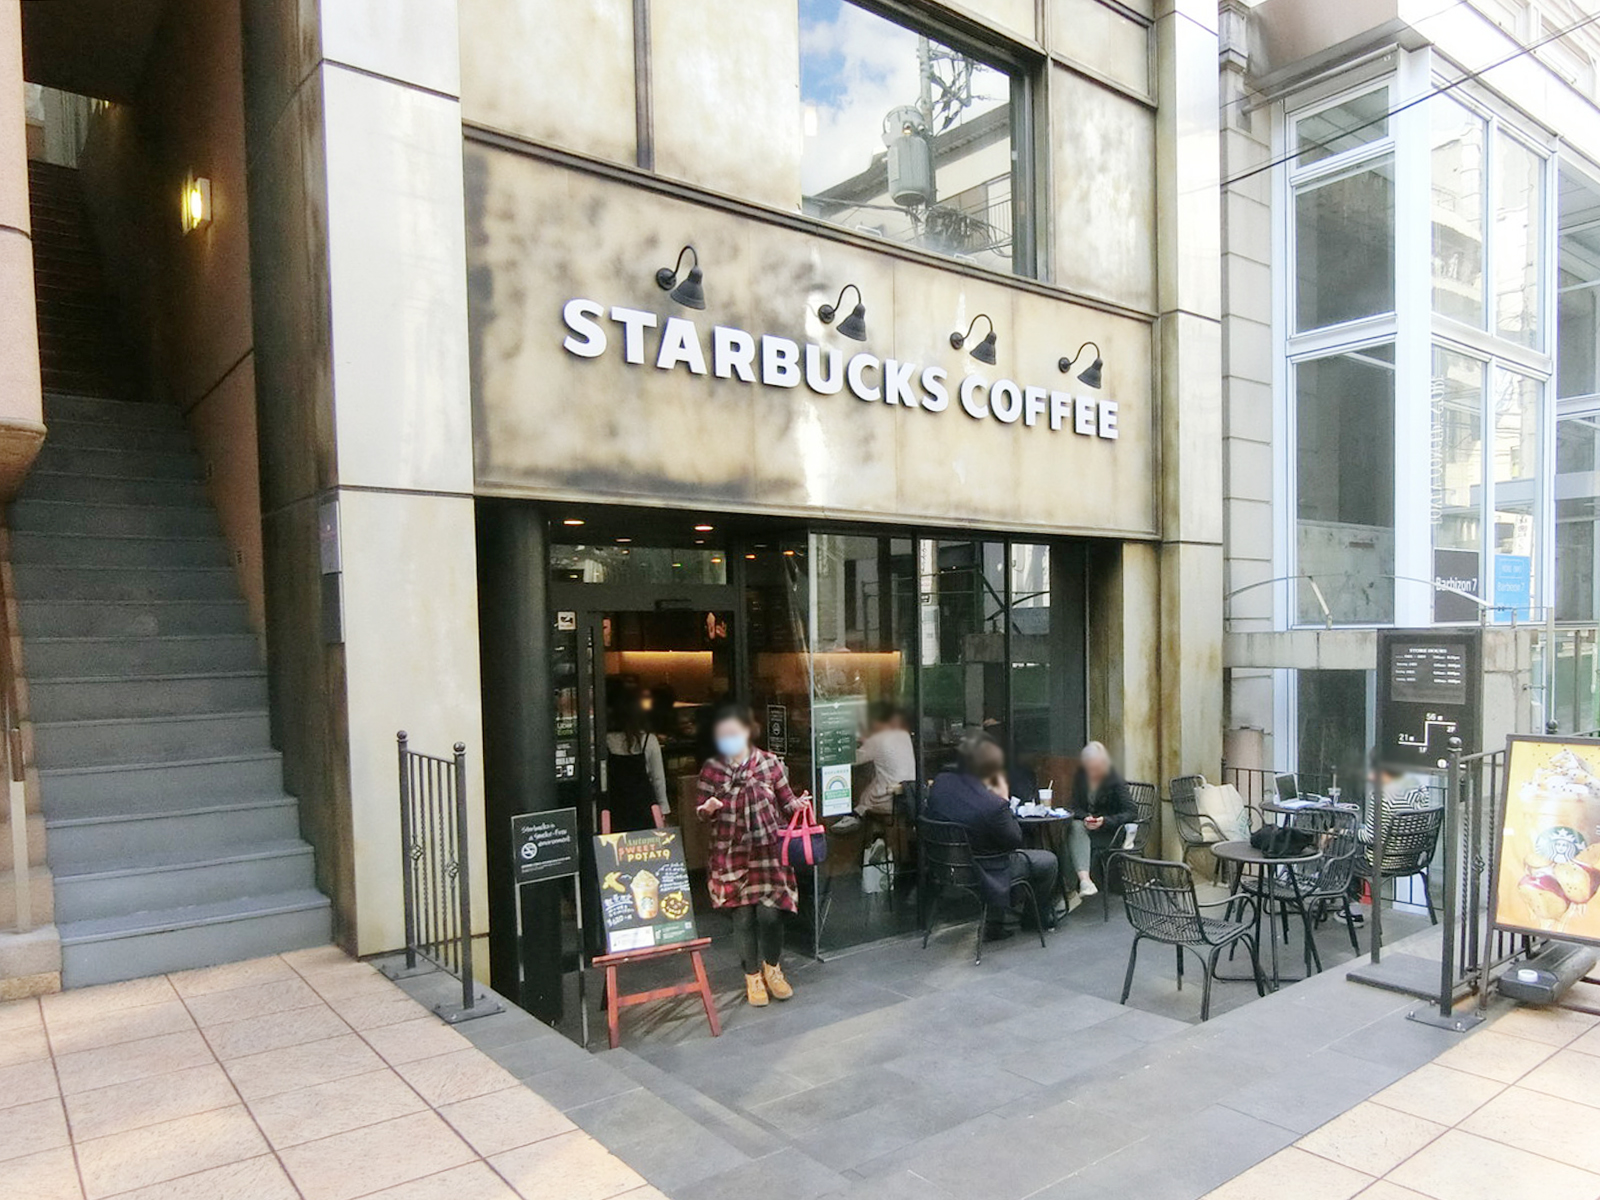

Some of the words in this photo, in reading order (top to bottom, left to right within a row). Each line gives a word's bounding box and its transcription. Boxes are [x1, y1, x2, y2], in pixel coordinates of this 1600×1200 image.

[562, 298, 950, 413] STARBUCKS
[960, 375, 1119, 440] COFFEE
[1435, 576, 1472, 592] Barbizon
[1472, 577, 1478, 592] 7
[627, 849, 671, 862] POTATO
